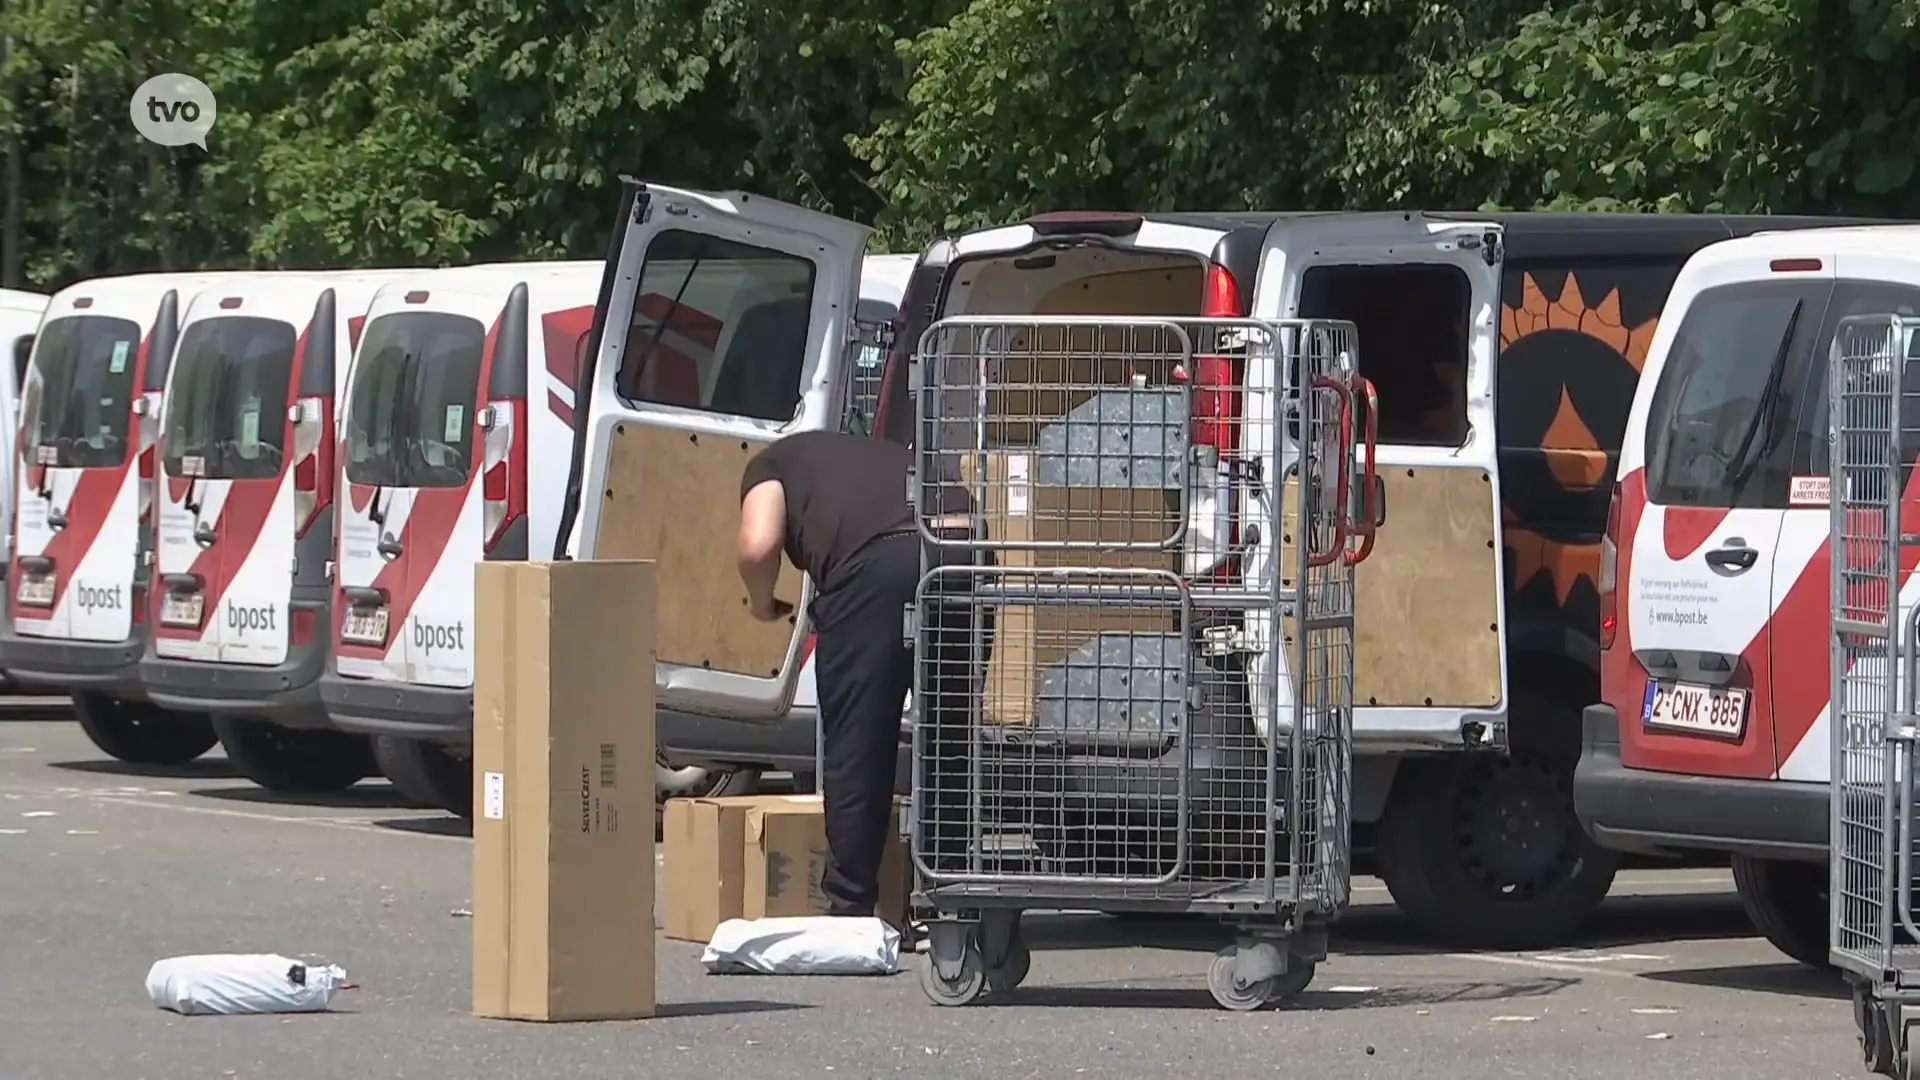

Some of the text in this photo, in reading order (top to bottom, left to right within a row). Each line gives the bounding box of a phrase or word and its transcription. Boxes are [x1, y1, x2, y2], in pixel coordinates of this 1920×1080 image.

[78, 579, 122, 615] bpost
[228, 598, 276, 637] bpost
[1656, 607, 1708, 628] www.bpost.be
[414, 615, 464, 657] bpost
[1644, 704, 1651, 718] B
